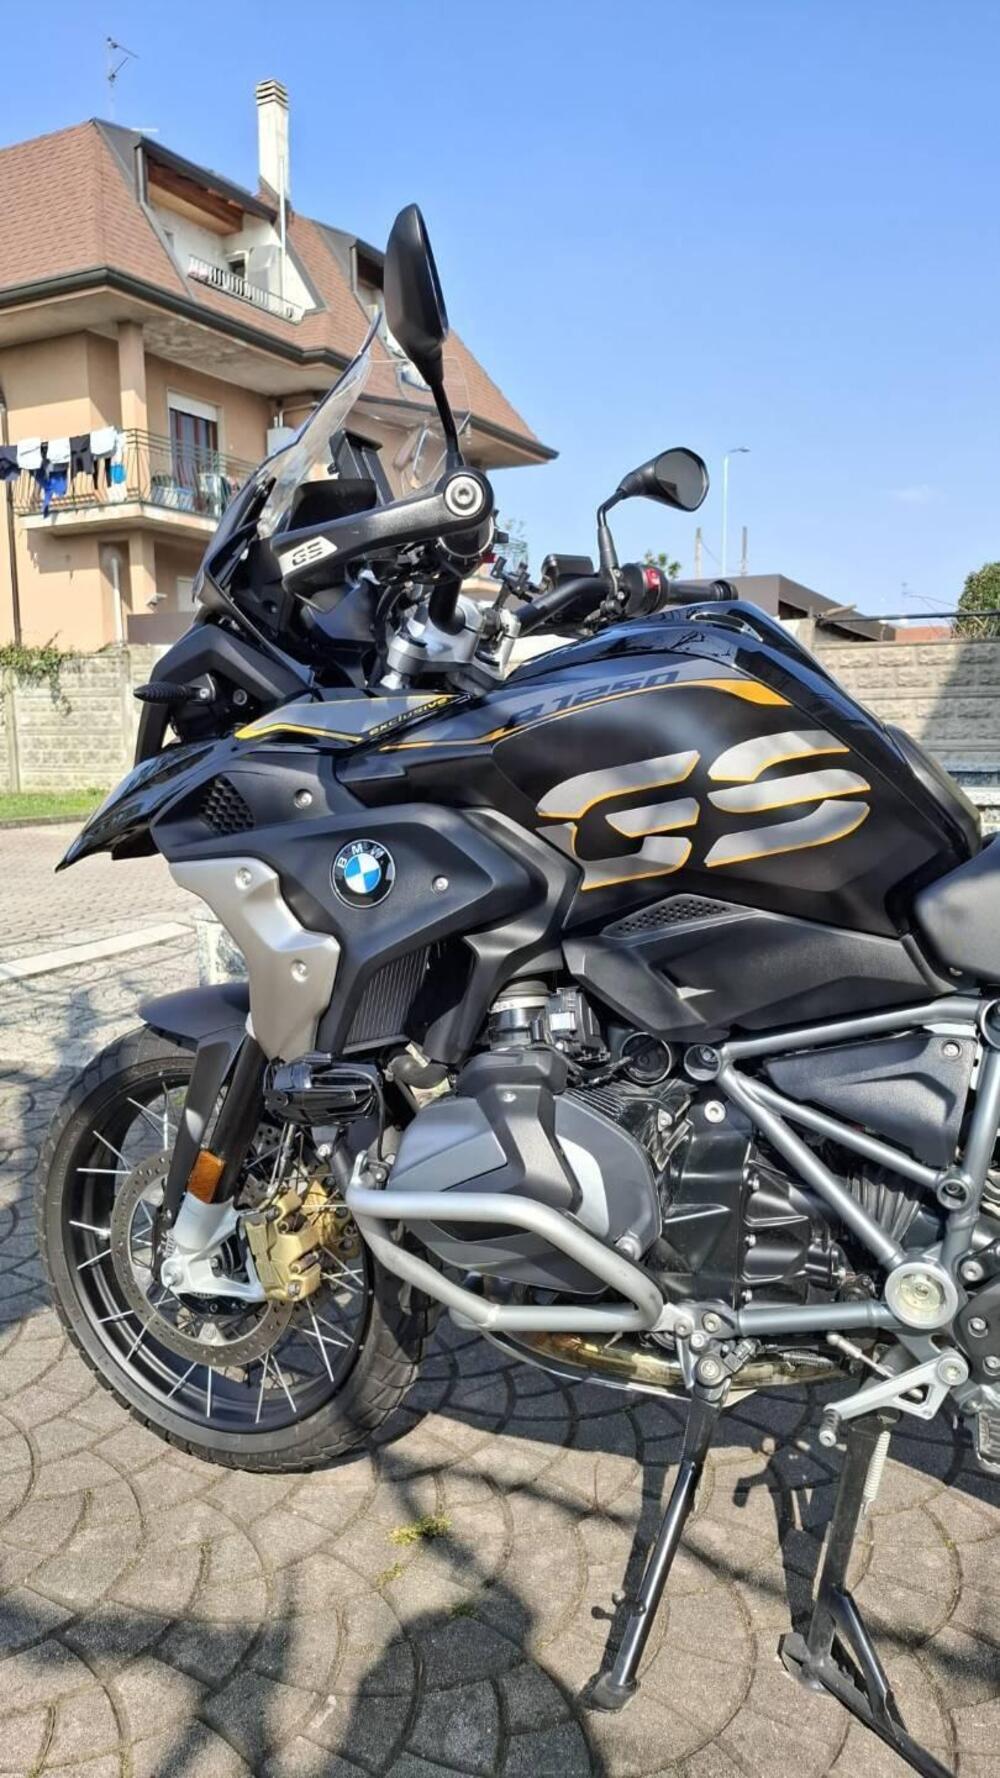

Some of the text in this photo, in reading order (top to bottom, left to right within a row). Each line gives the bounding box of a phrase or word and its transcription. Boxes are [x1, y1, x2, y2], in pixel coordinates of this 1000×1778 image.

[292, 541, 323, 566] GS
[535, 731, 871, 891] GS
[336, 843, 385, 869] BMW
